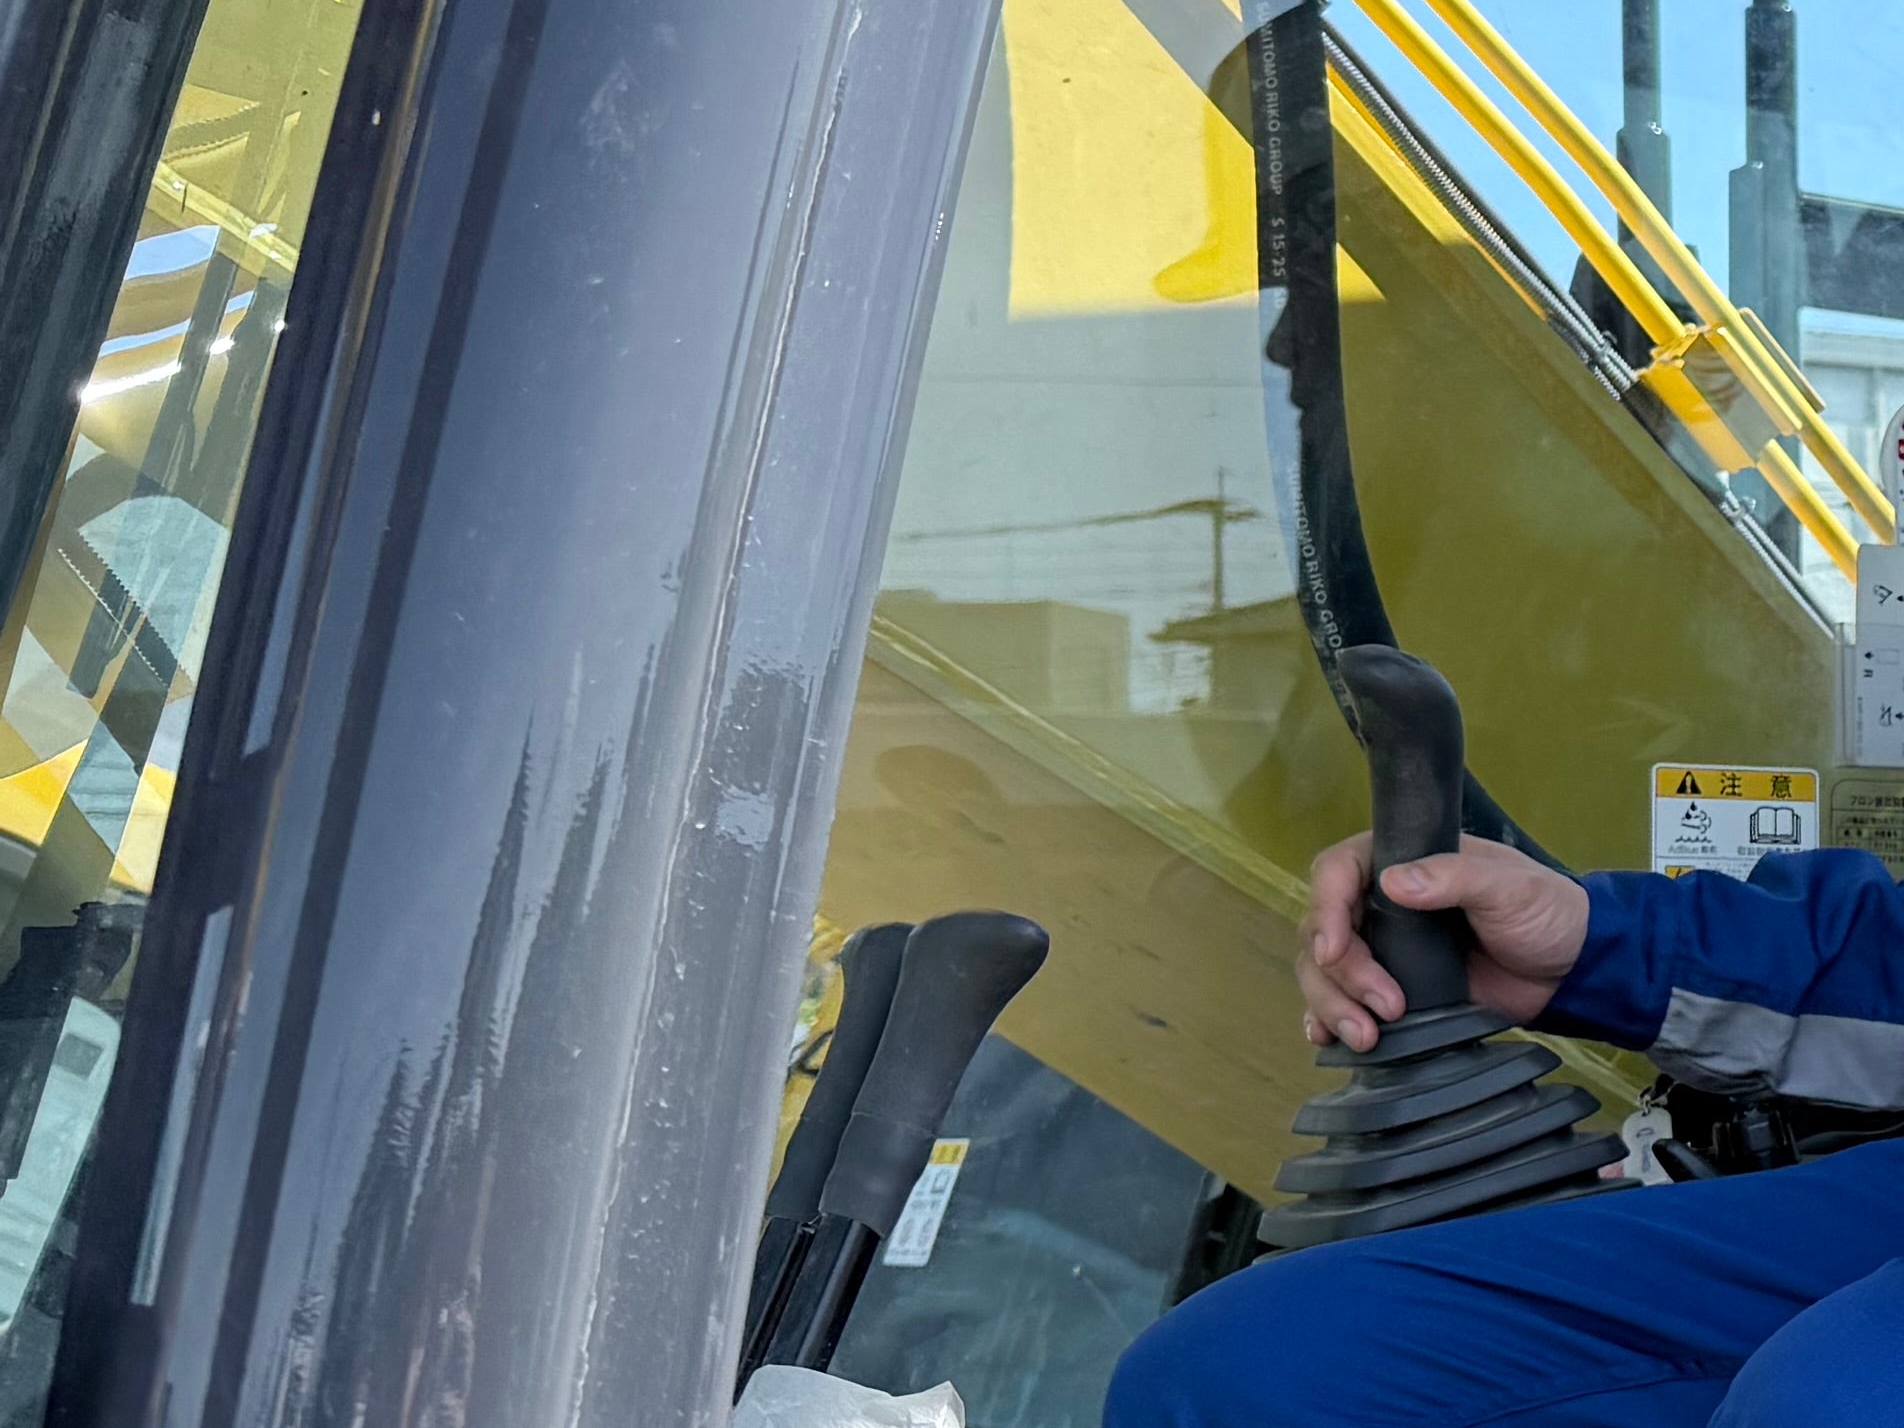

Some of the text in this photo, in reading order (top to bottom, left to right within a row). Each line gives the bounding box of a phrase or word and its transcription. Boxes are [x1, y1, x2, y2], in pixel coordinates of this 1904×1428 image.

[1256, 1, 1278, 89] SUMITOMO
[1265, 92, 1281, 132] RIKO
[1268, 136, 1283, 196] GROUP
[1306, 559, 1327, 605] RIKO
[1720, 772, 1792, 798] 注意
